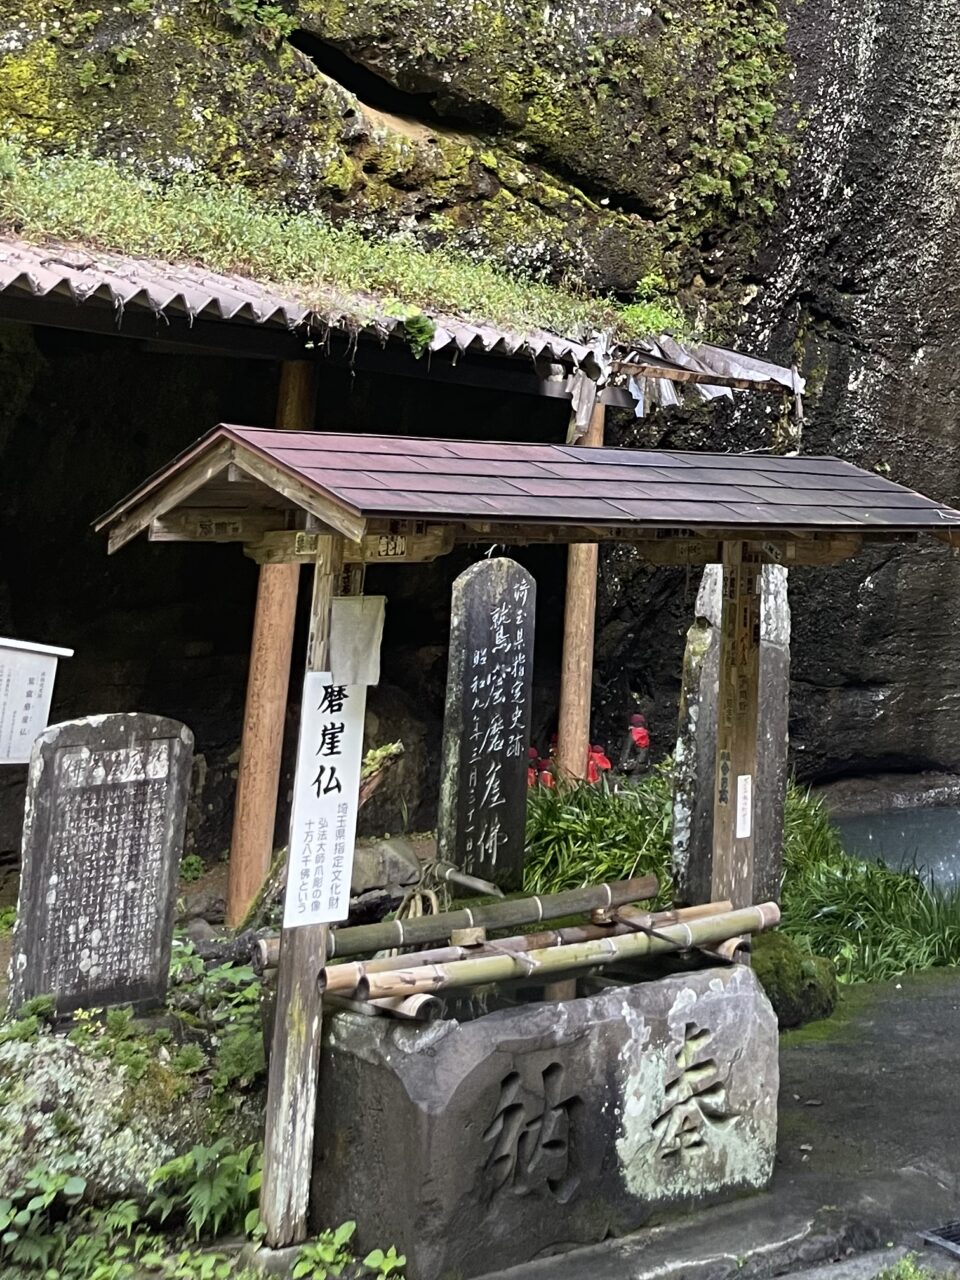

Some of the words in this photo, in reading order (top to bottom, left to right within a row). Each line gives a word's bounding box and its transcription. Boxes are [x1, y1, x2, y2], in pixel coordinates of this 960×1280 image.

[312, 684, 349, 798] 磨崖仏
[311, 817, 328, 912] 弘法大師爪彫の像
[328, 802, 349, 910] 埼玉県指定文化財
